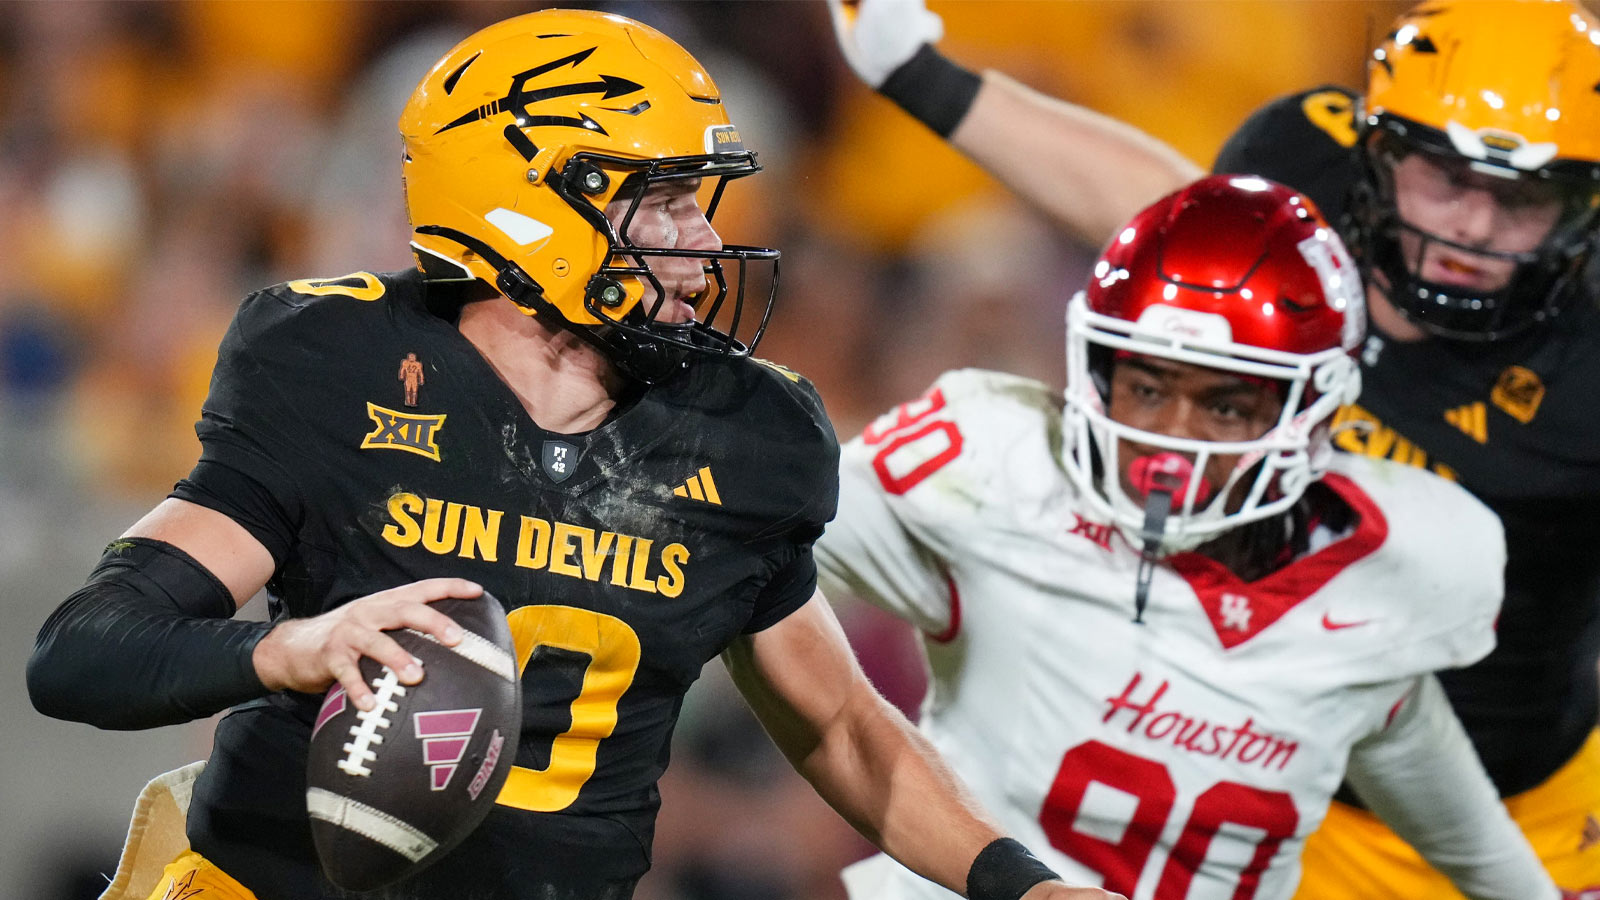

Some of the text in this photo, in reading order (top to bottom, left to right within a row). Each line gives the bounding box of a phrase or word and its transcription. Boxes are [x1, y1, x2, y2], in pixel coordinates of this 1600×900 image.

[715, 131, 732, 144] SUN
[551, 461, 566, 474] 42
[553, 446, 568, 459] PT
[382, 493, 690, 598] SUN DEVILS
[1102, 671, 1299, 772] Houston
[1038, 739, 1299, 900] 90
